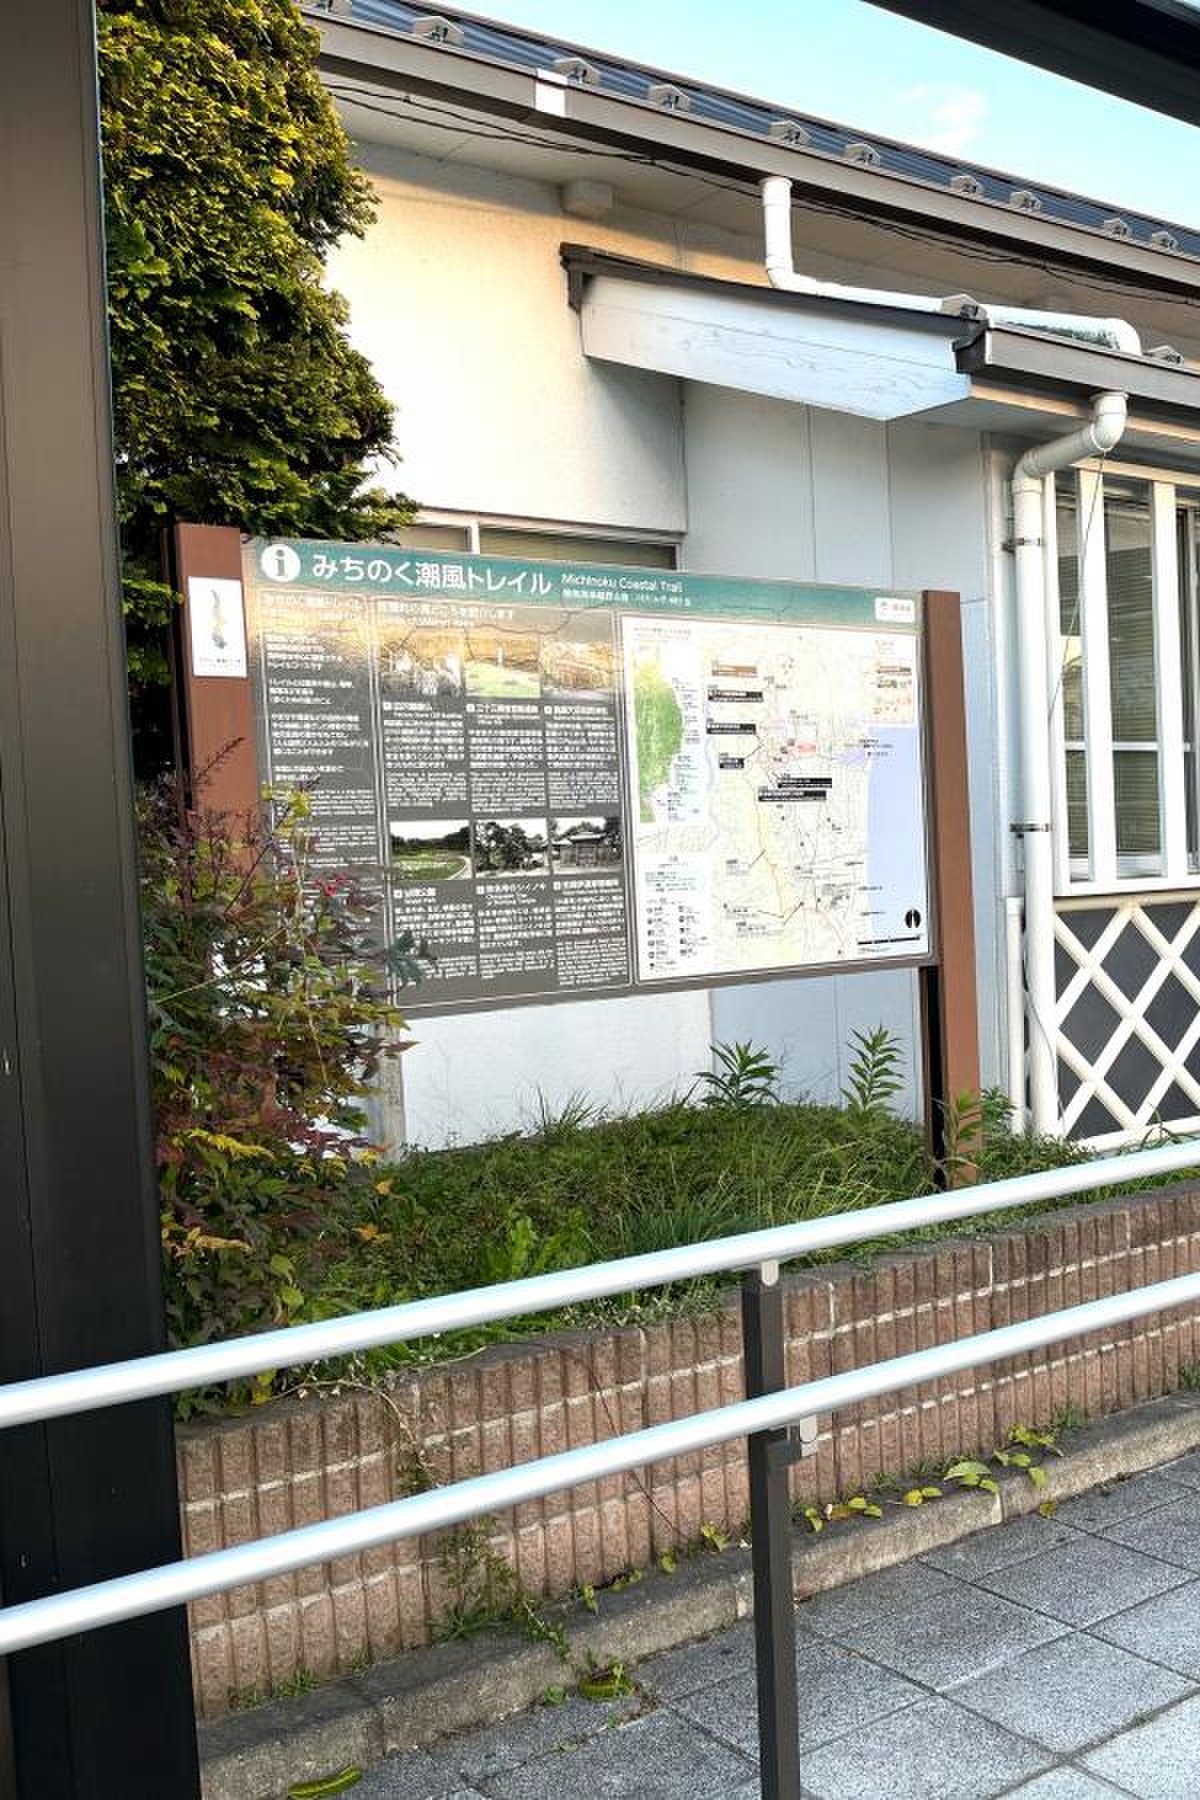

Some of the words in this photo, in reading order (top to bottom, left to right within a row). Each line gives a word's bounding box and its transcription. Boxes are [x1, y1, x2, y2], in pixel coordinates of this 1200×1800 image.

[311, 553, 552, 596] みちのく潮風トレイル
[561, 573, 617, 588] Michinoku
[619, 577, 657, 591] Coastal
[660, 581, 683, 593] Trail
